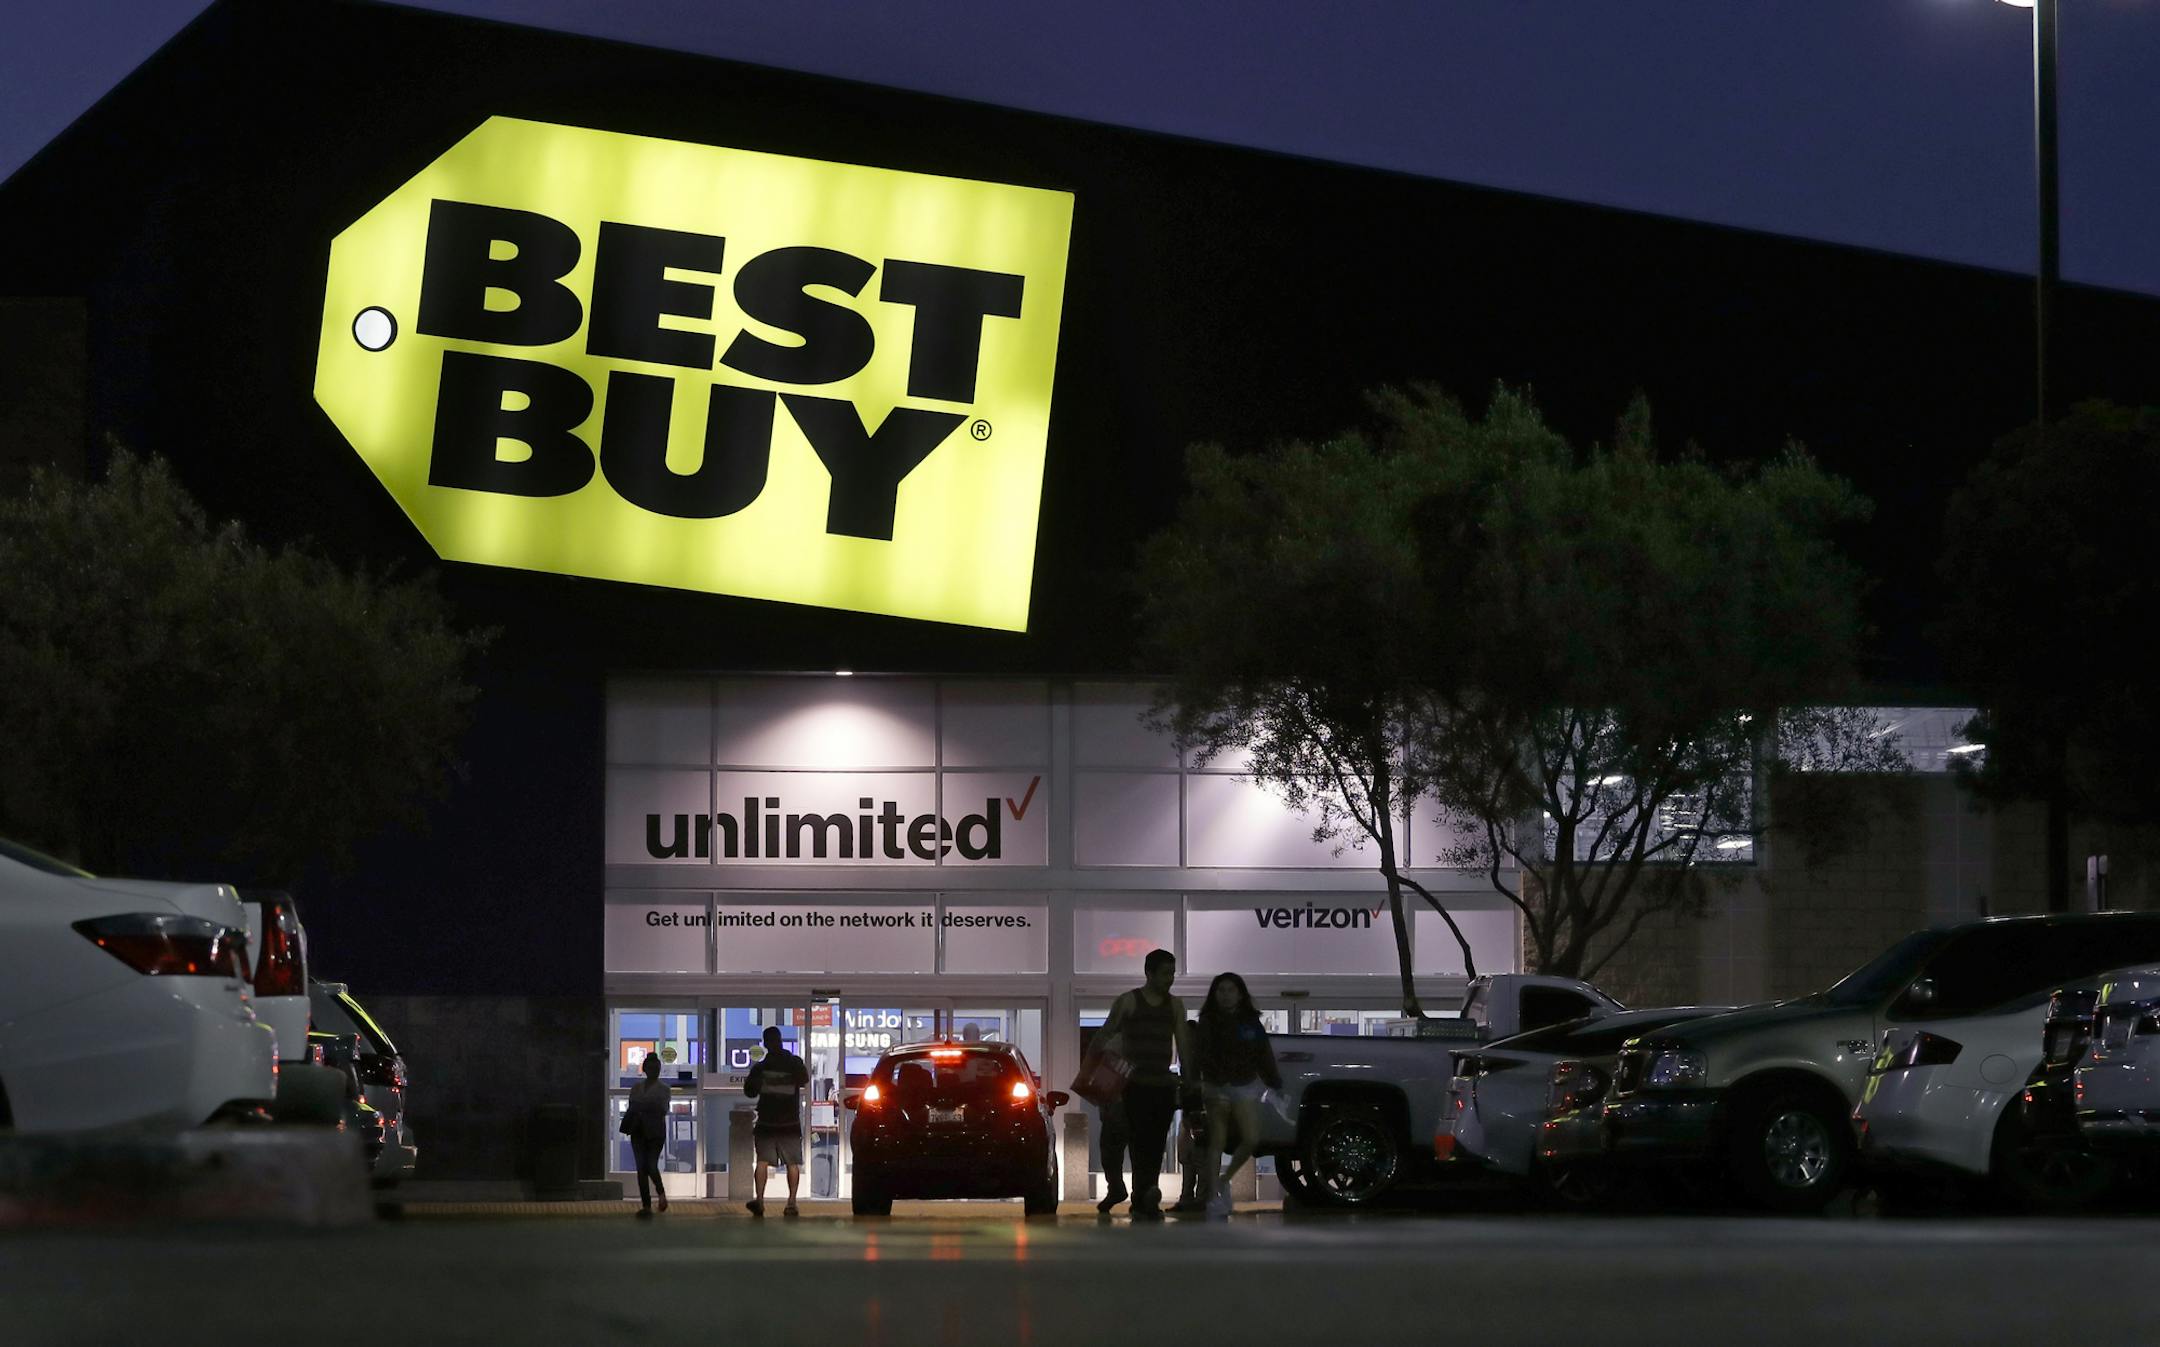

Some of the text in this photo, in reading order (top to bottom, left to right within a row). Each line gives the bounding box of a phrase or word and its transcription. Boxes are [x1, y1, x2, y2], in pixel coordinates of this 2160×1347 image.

[416, 199, 1025, 404] BEST
[646, 797, 1001, 860] unlimited
[646, 911, 1032, 928] Get unlimited on the network it deserves.
[1254, 902, 1371, 929] verizon
